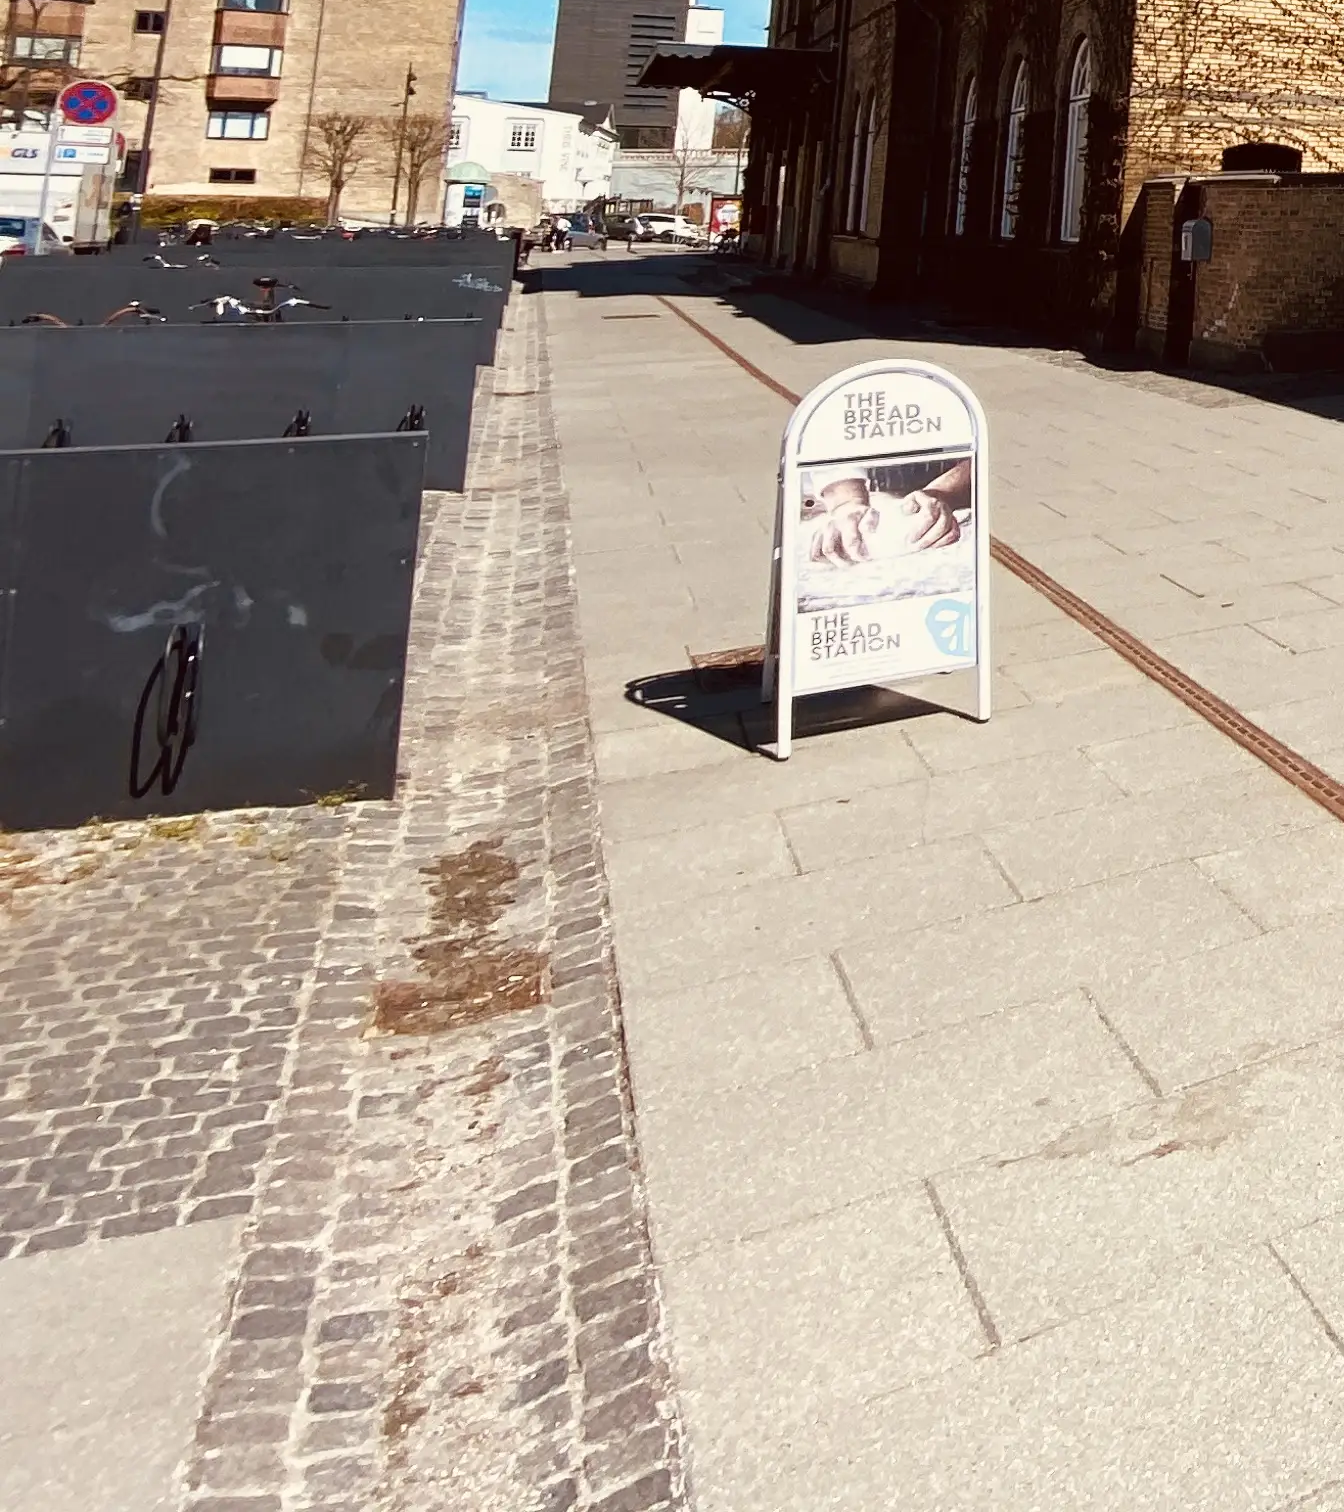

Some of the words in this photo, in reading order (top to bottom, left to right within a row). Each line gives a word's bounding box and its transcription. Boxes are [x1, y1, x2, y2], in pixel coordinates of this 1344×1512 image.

[11, 148, 39, 159] GLS
[843, 391, 885, 408] THE
[843, 403, 921, 424] BREAD
[843, 416, 942, 441] STATION
[810, 611, 850, 631] THE
[811, 623, 882, 646] BREAD
[810, 633, 901, 661] STATION
